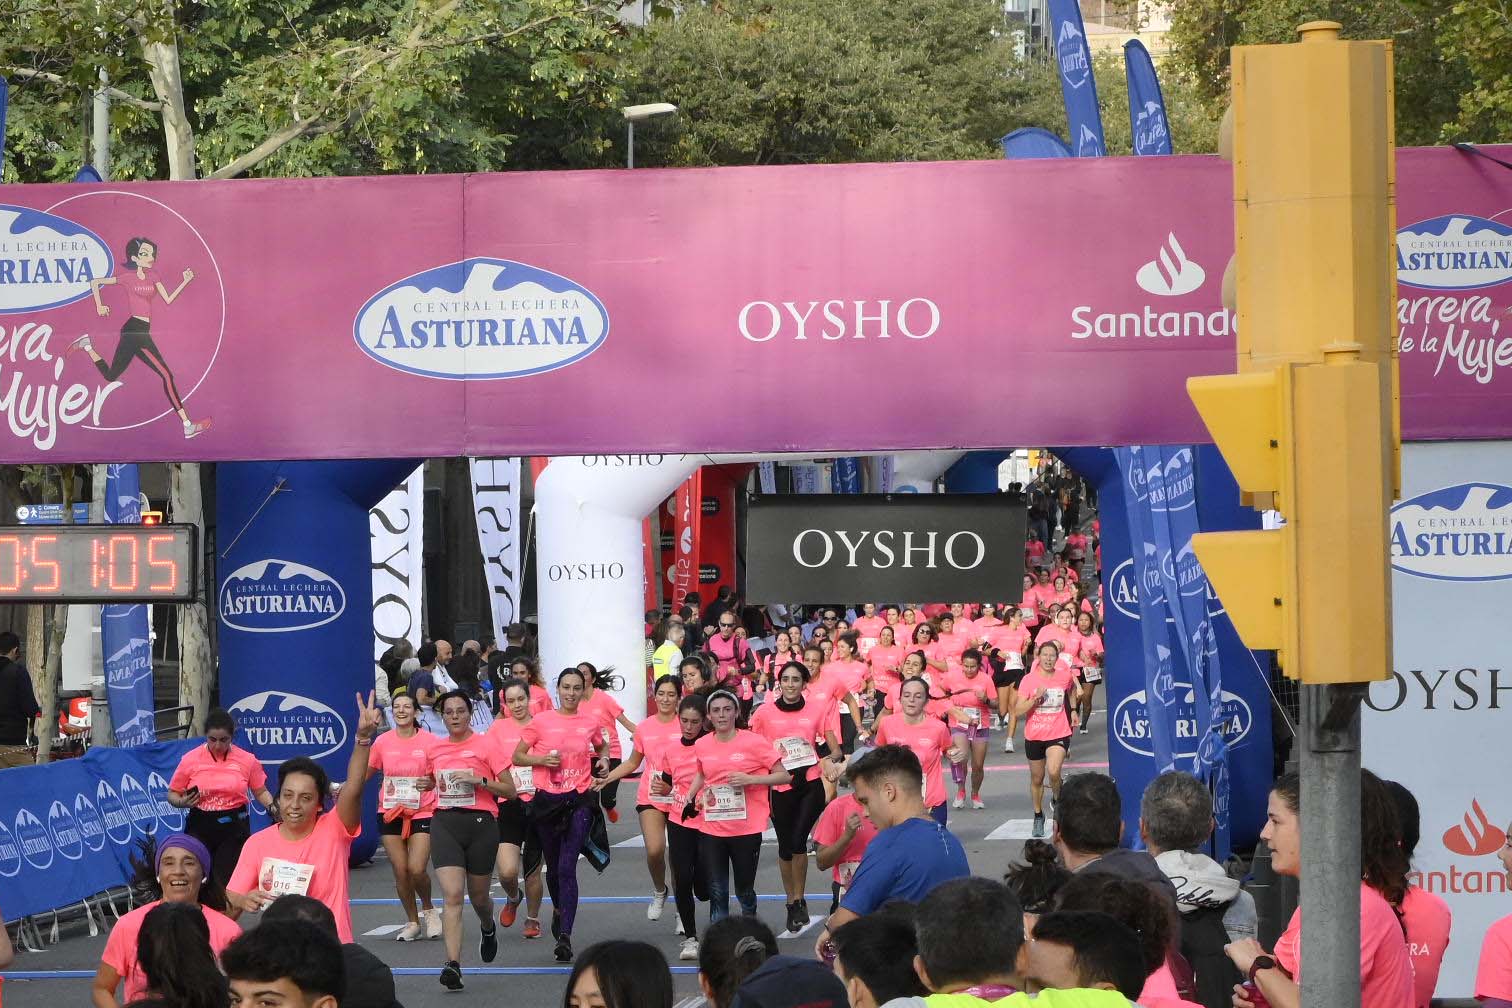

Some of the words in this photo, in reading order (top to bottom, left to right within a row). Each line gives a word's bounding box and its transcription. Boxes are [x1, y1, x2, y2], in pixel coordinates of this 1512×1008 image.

[16, 241, 88, 252] LECHERA
[1467, 239, 1512, 248] LECHER
[413, 300, 491, 314] CENTRAL
[500, 298, 580, 311] LECHERA
[738, 297, 941, 342] OYSHO
[1397, 294, 1492, 325] arrera
[374, 305, 589, 350] ASTURIANA
[1071, 305, 1237, 339] Santand
[1420, 325, 1438, 353] la
[1433, 321, 1512, 384] Muje
[1418, 517, 1480, 528] CENTRAL
[792, 528, 986, 570] OYSHO
[548, 562, 624, 582] OYSHO
[283, 583, 332, 592] LECHERA
[223, 588, 337, 616] ASTURIANA
[1362, 668, 1512, 711] OYSH
[283, 715, 332, 724] LECHERA
